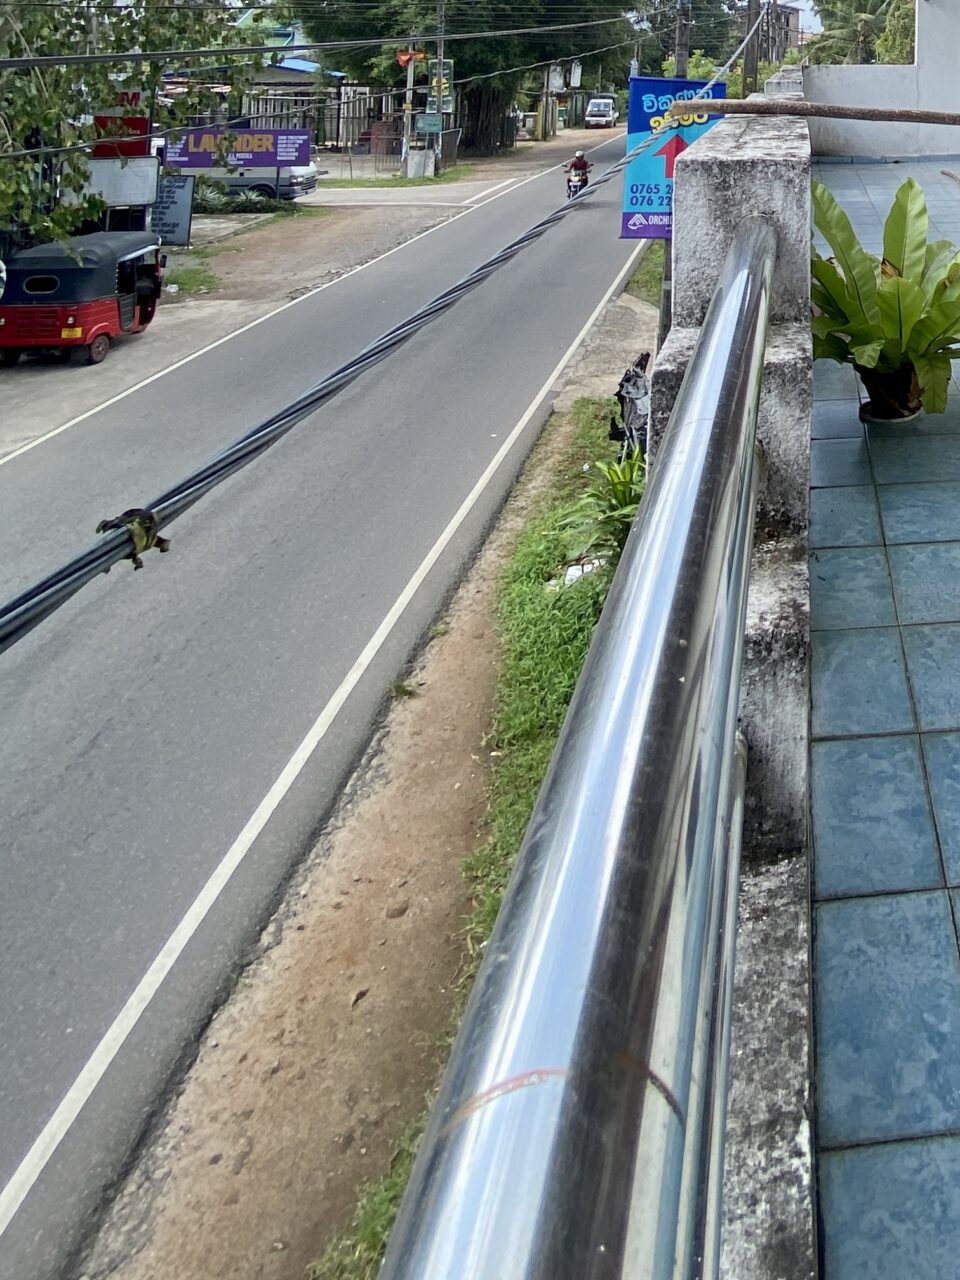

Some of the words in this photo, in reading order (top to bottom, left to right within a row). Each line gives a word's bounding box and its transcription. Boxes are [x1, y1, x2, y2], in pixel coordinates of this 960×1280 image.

[188, 134, 274, 153] LAVNDER
[630, 183, 660, 195] 0765
[630, 195, 654, 207] 076
